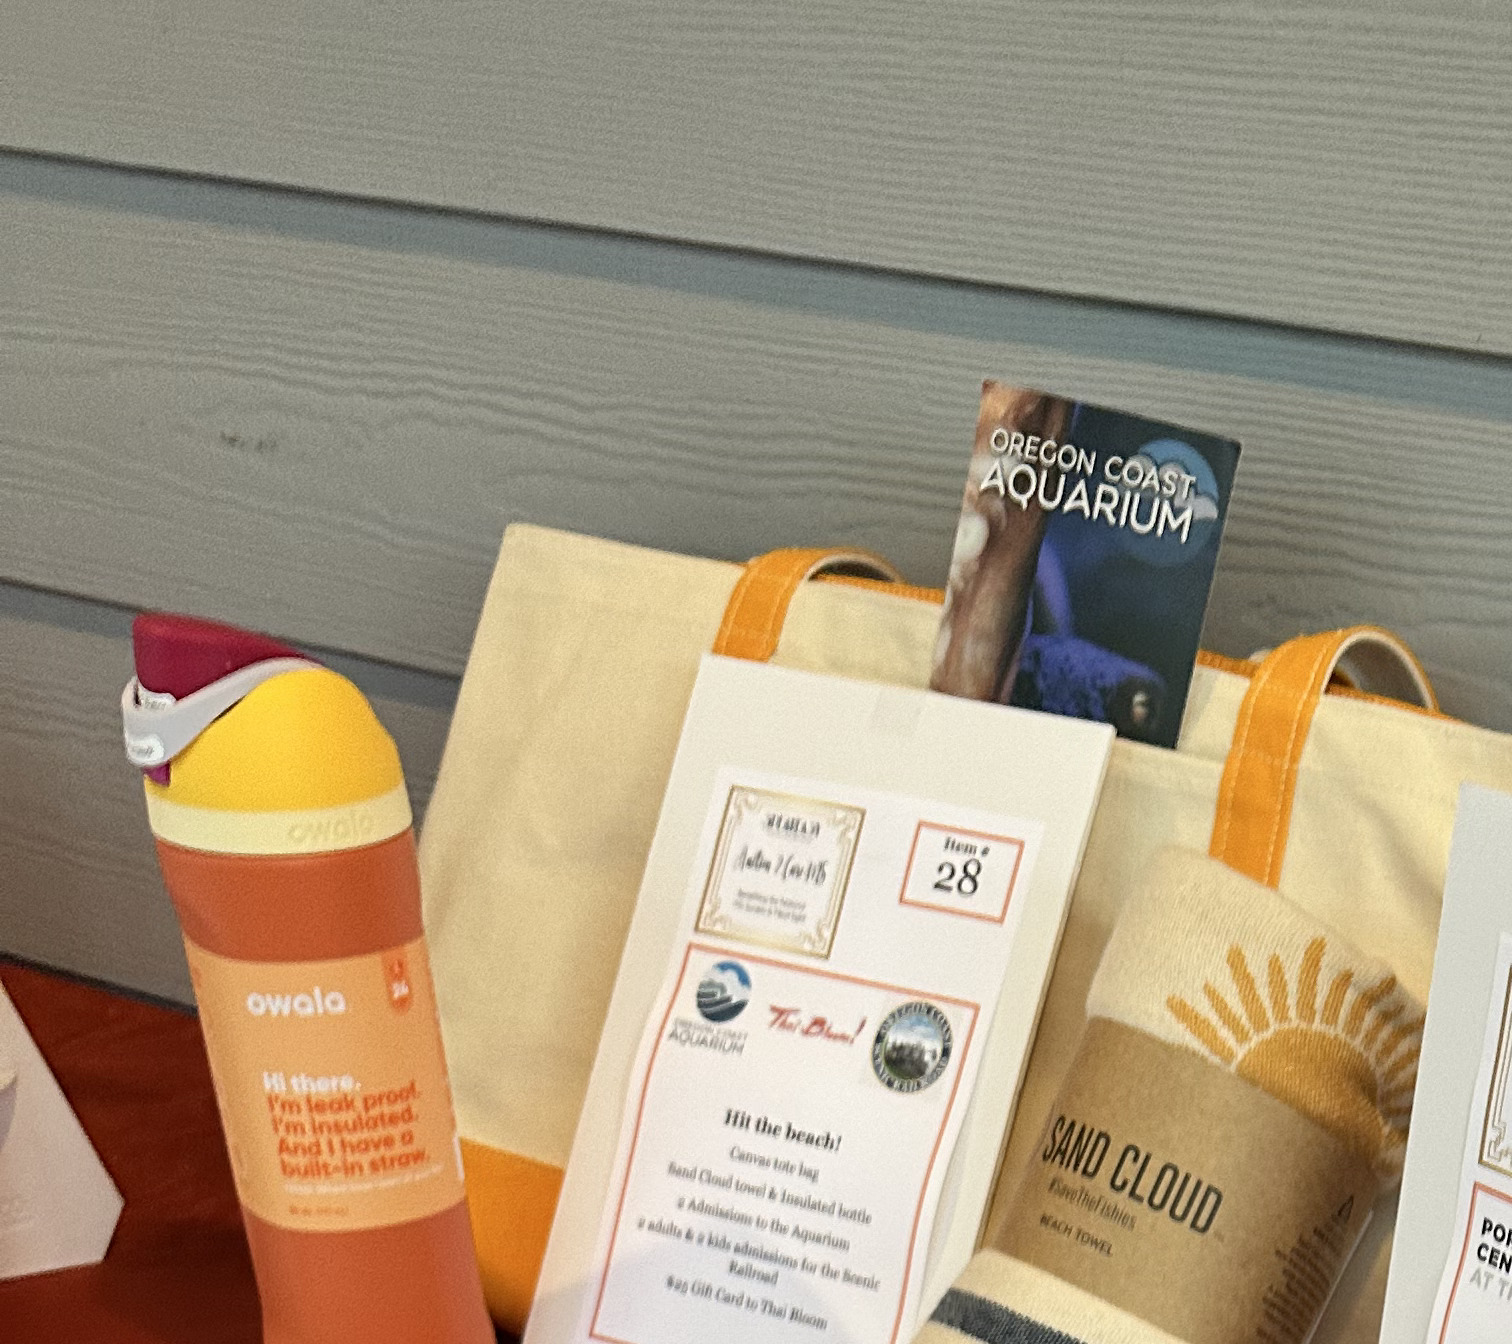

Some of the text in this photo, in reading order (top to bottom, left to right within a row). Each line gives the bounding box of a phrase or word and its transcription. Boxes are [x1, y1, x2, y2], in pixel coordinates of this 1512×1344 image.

[990, 428, 1197, 499] OREGON COAST
[979, 460, 1194, 544] AQUARIUM
[287, 809, 374, 844] owala
[933, 858, 982, 895] 28
[247, 986, 347, 1017] owala
[667, 1024, 747, 1056] AQUARIUM
[724, 1109, 842, 1151] Hit the beach!
[1042, 1113, 1224, 1236] SAND CLOUD
[1039, 1213, 1114, 1257] BEACH TOWEL
[1469, 1267, 1495, 1291] AT
